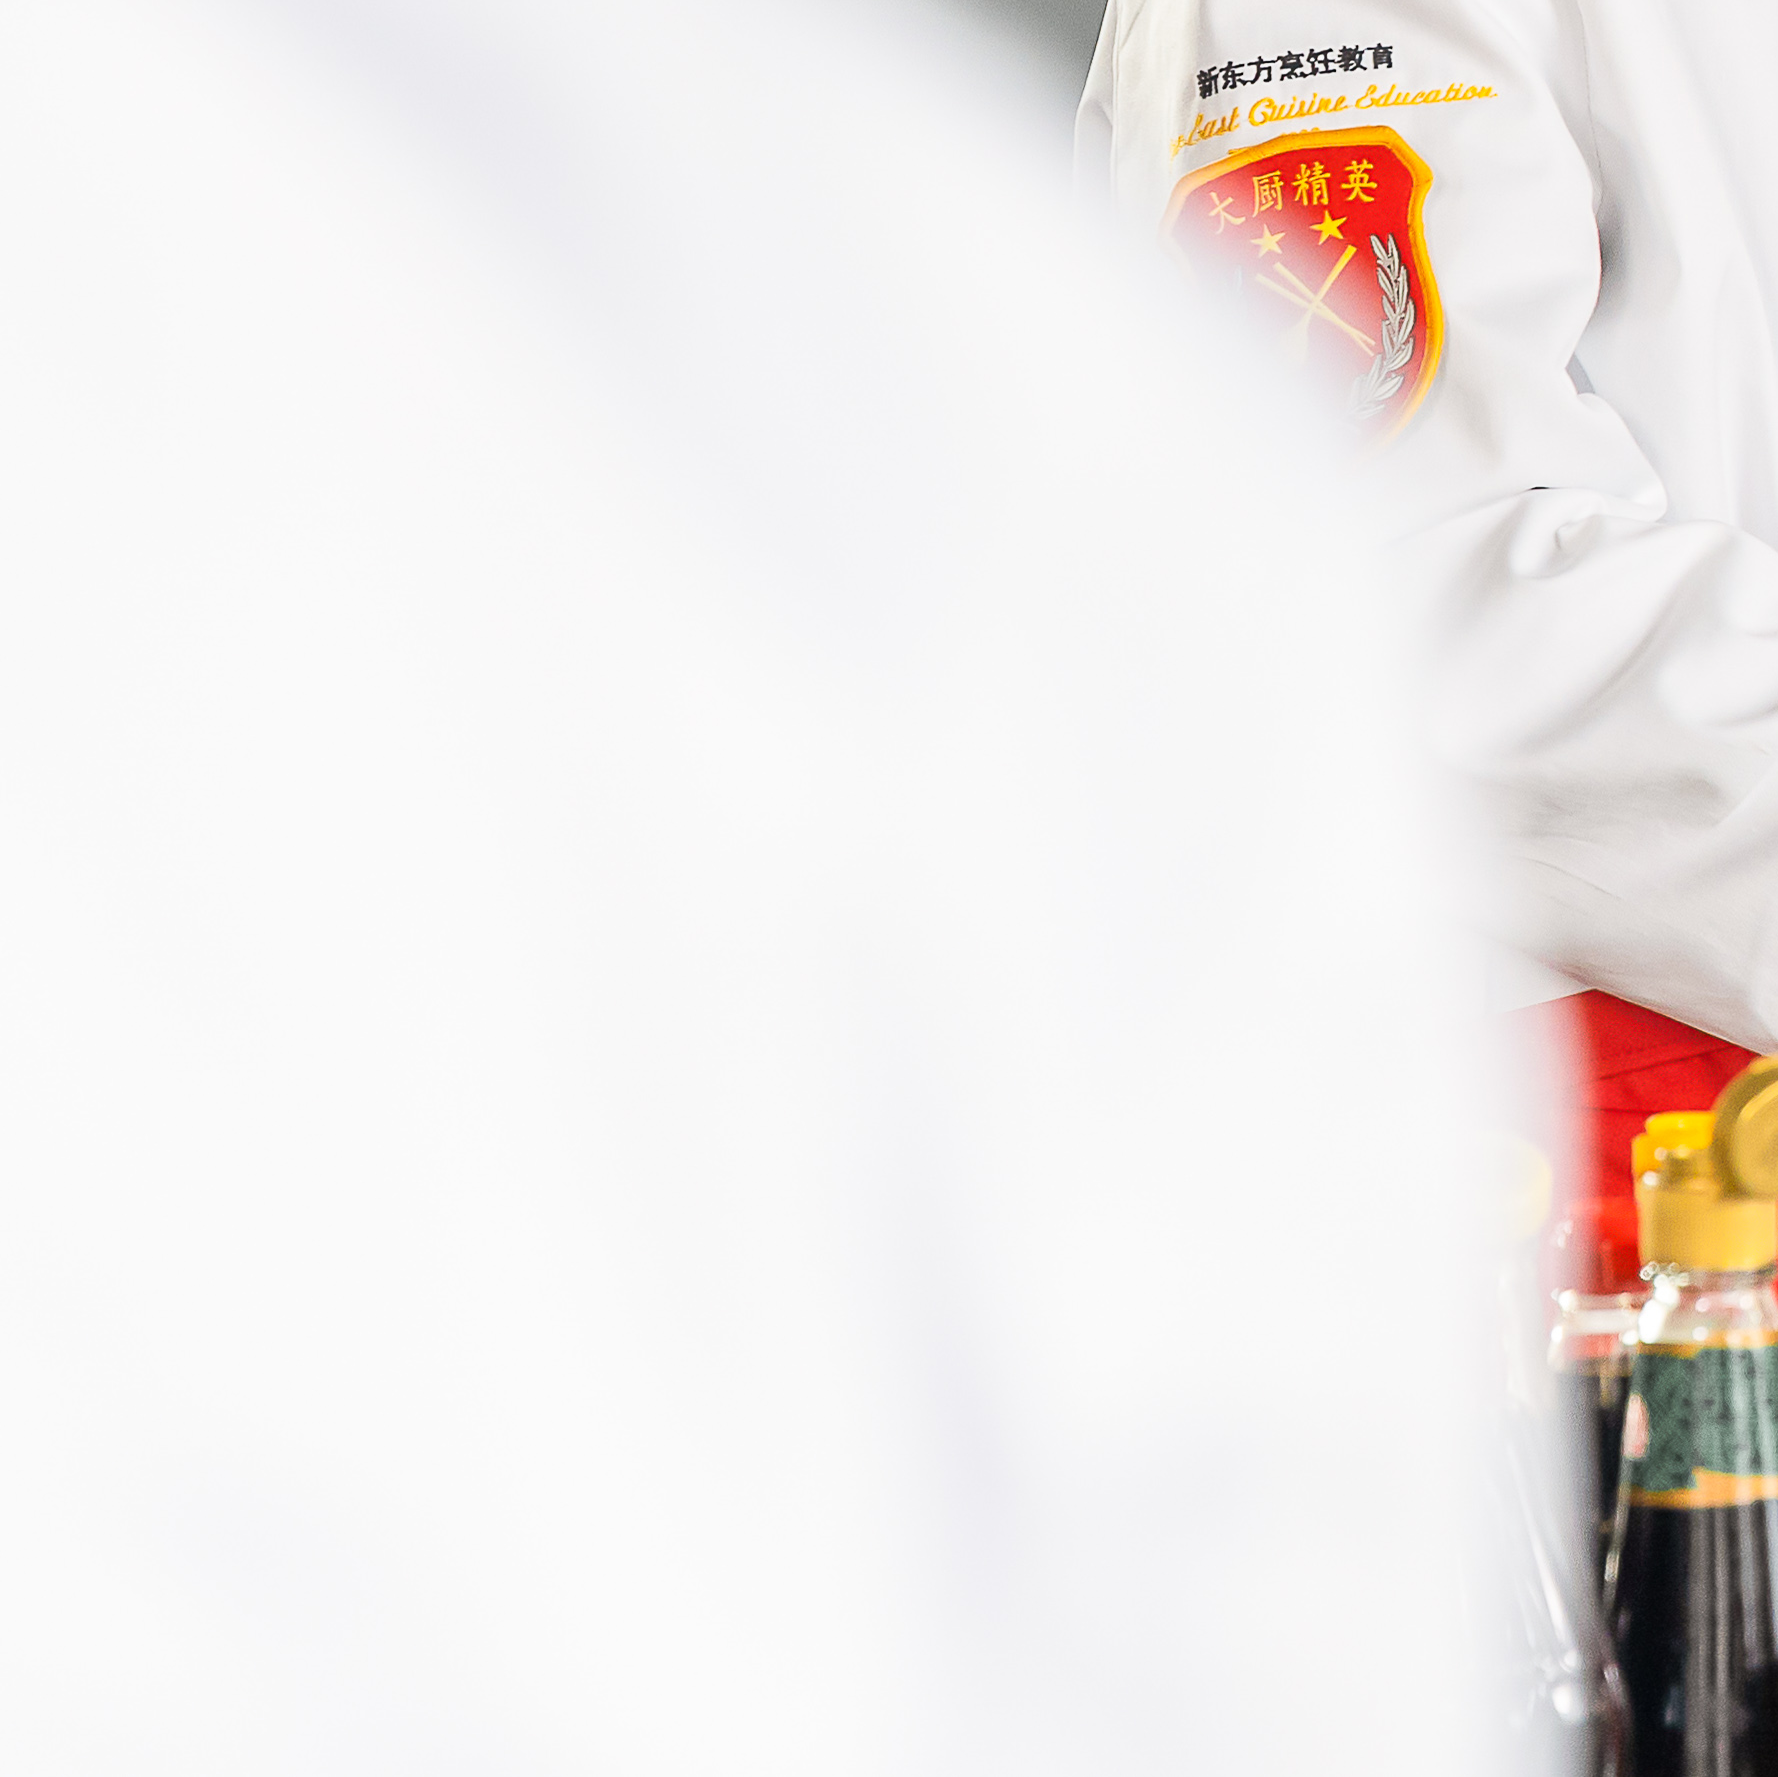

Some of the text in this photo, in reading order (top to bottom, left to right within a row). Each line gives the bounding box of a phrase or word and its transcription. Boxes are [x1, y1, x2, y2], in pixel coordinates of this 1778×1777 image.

[1197, 42, 1394, 99] 新东方烹饪教育
[1248, 92, 1348, 127] Cuisine
[1208, 158, 1378, 235] 大厨精英
